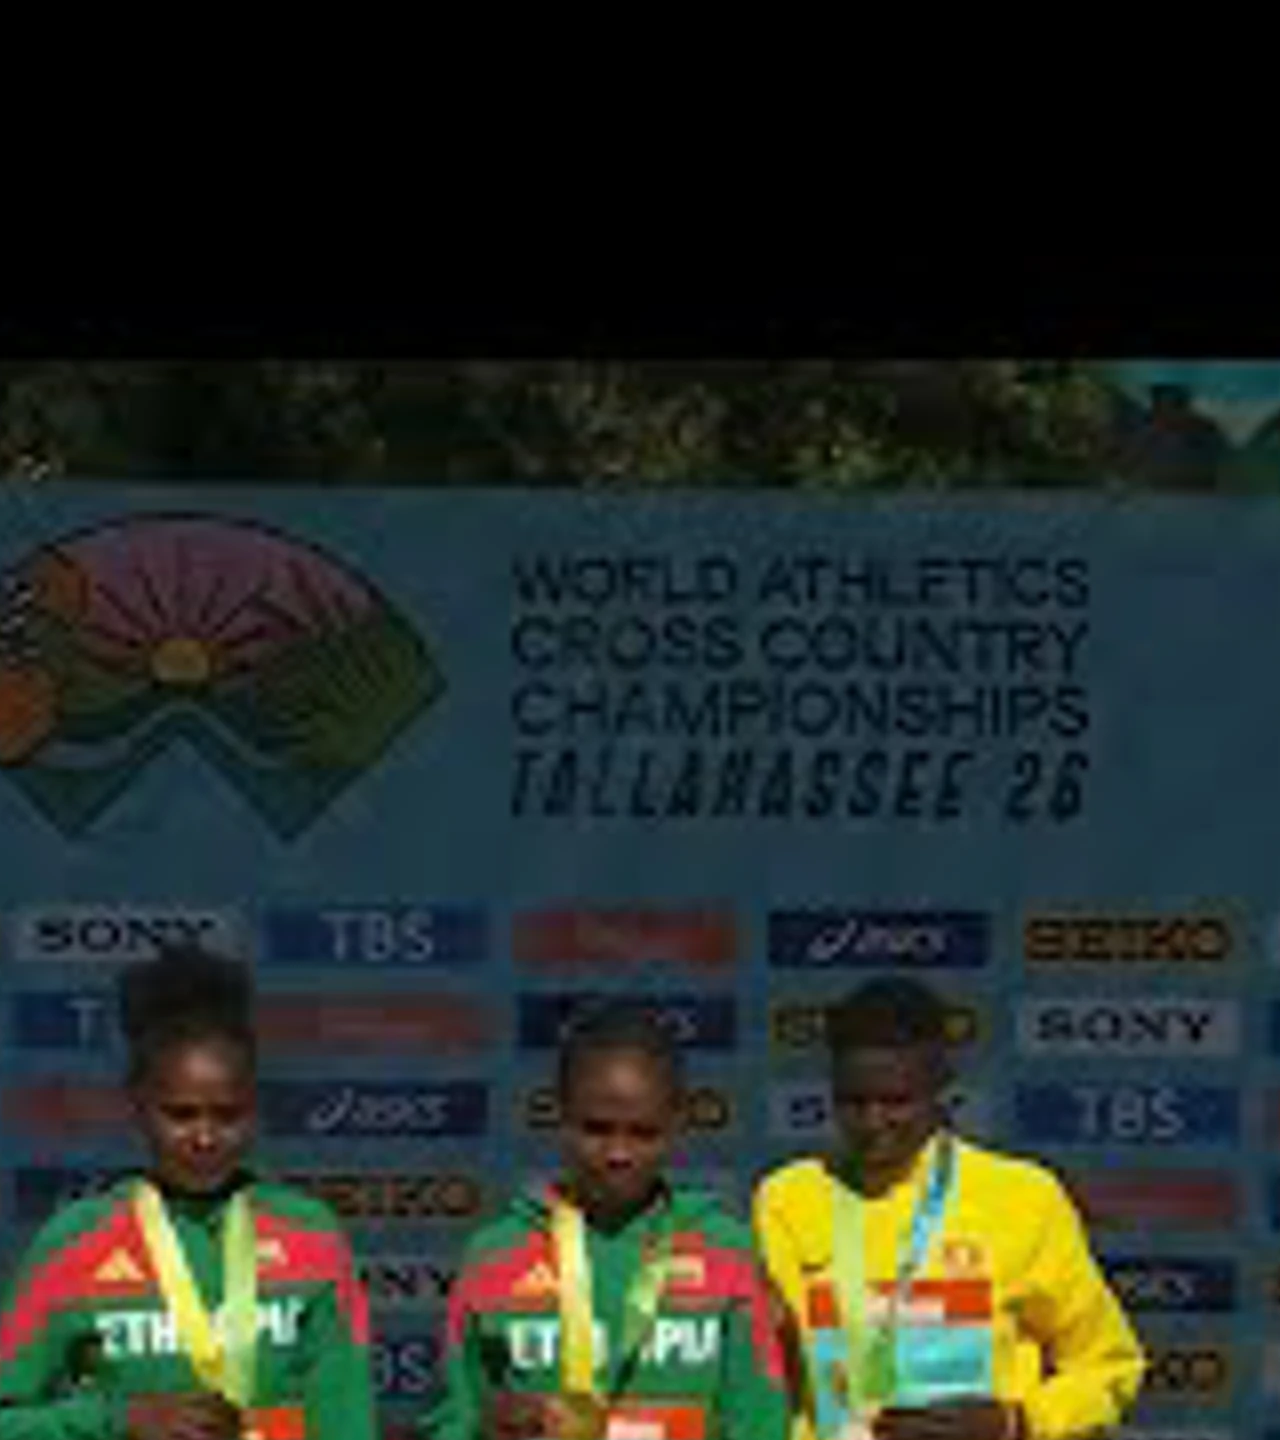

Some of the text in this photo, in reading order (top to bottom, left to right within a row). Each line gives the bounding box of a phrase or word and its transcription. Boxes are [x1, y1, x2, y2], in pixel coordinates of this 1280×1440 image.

[514, 557, 1089, 606] WORLD ATHLETICS
[512, 616, 1089, 673] CROSS COUNTRY
[512, 679, 1089, 737] CHAMPIONSHIPS
[513, 748, 974, 818] TALLAHASSEE
[321, 912, 438, 962] TBS
[1025, 918, 1232, 961] SEIKO
[1036, 1008, 1215, 1042] SONY
[1071, 1089, 1188, 1139] TBS
